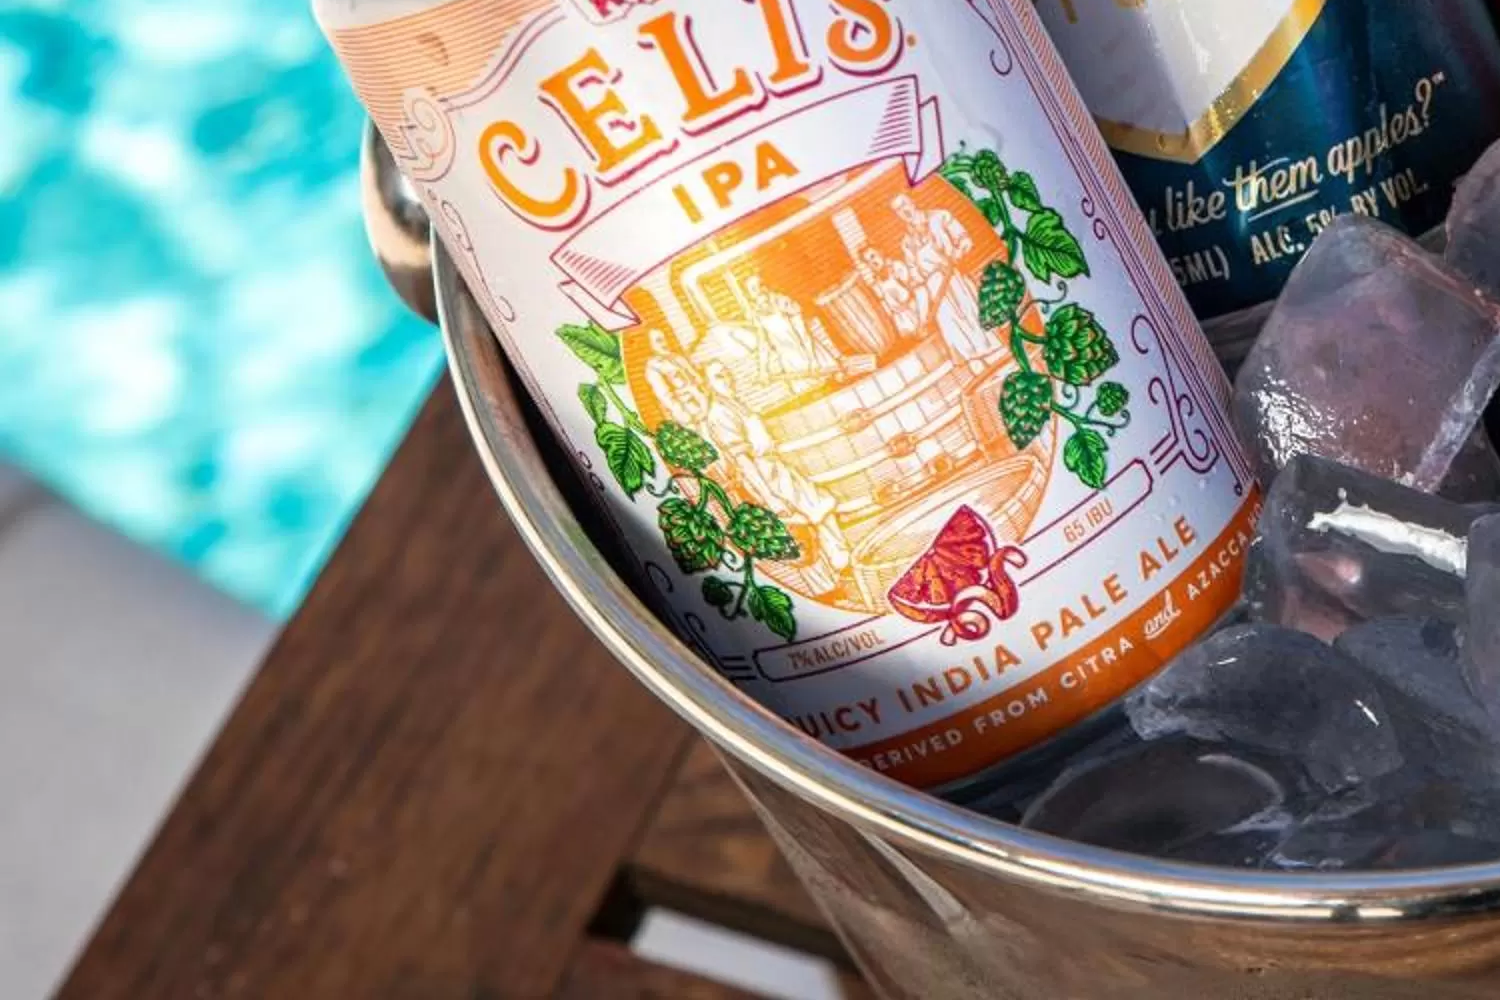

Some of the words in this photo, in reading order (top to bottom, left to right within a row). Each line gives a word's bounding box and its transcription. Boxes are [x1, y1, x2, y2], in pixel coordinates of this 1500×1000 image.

[672, 140, 800, 225] IPA
[1164, 179, 1227, 232] like
[1223, 155, 1324, 215] them
[1251, 224, 1305, 266] ALC.
[1350, 186, 1381, 217] BY
[1381, 167, 1430, 209] VOL.
[1063, 519, 1087, 544] 65
[1087, 498, 1114, 535] IBU
[896, 644, 1021, 714] INDIA
[1030, 573, 1129, 649] PALE
[1138, 515, 1196, 580] ALE
[973, 687, 1051, 735] FROM
[1059, 637, 1133, 691] CITRA
[1143, 588, 1182, 640] and
[1187, 530, 1247, 601] AZACCA
